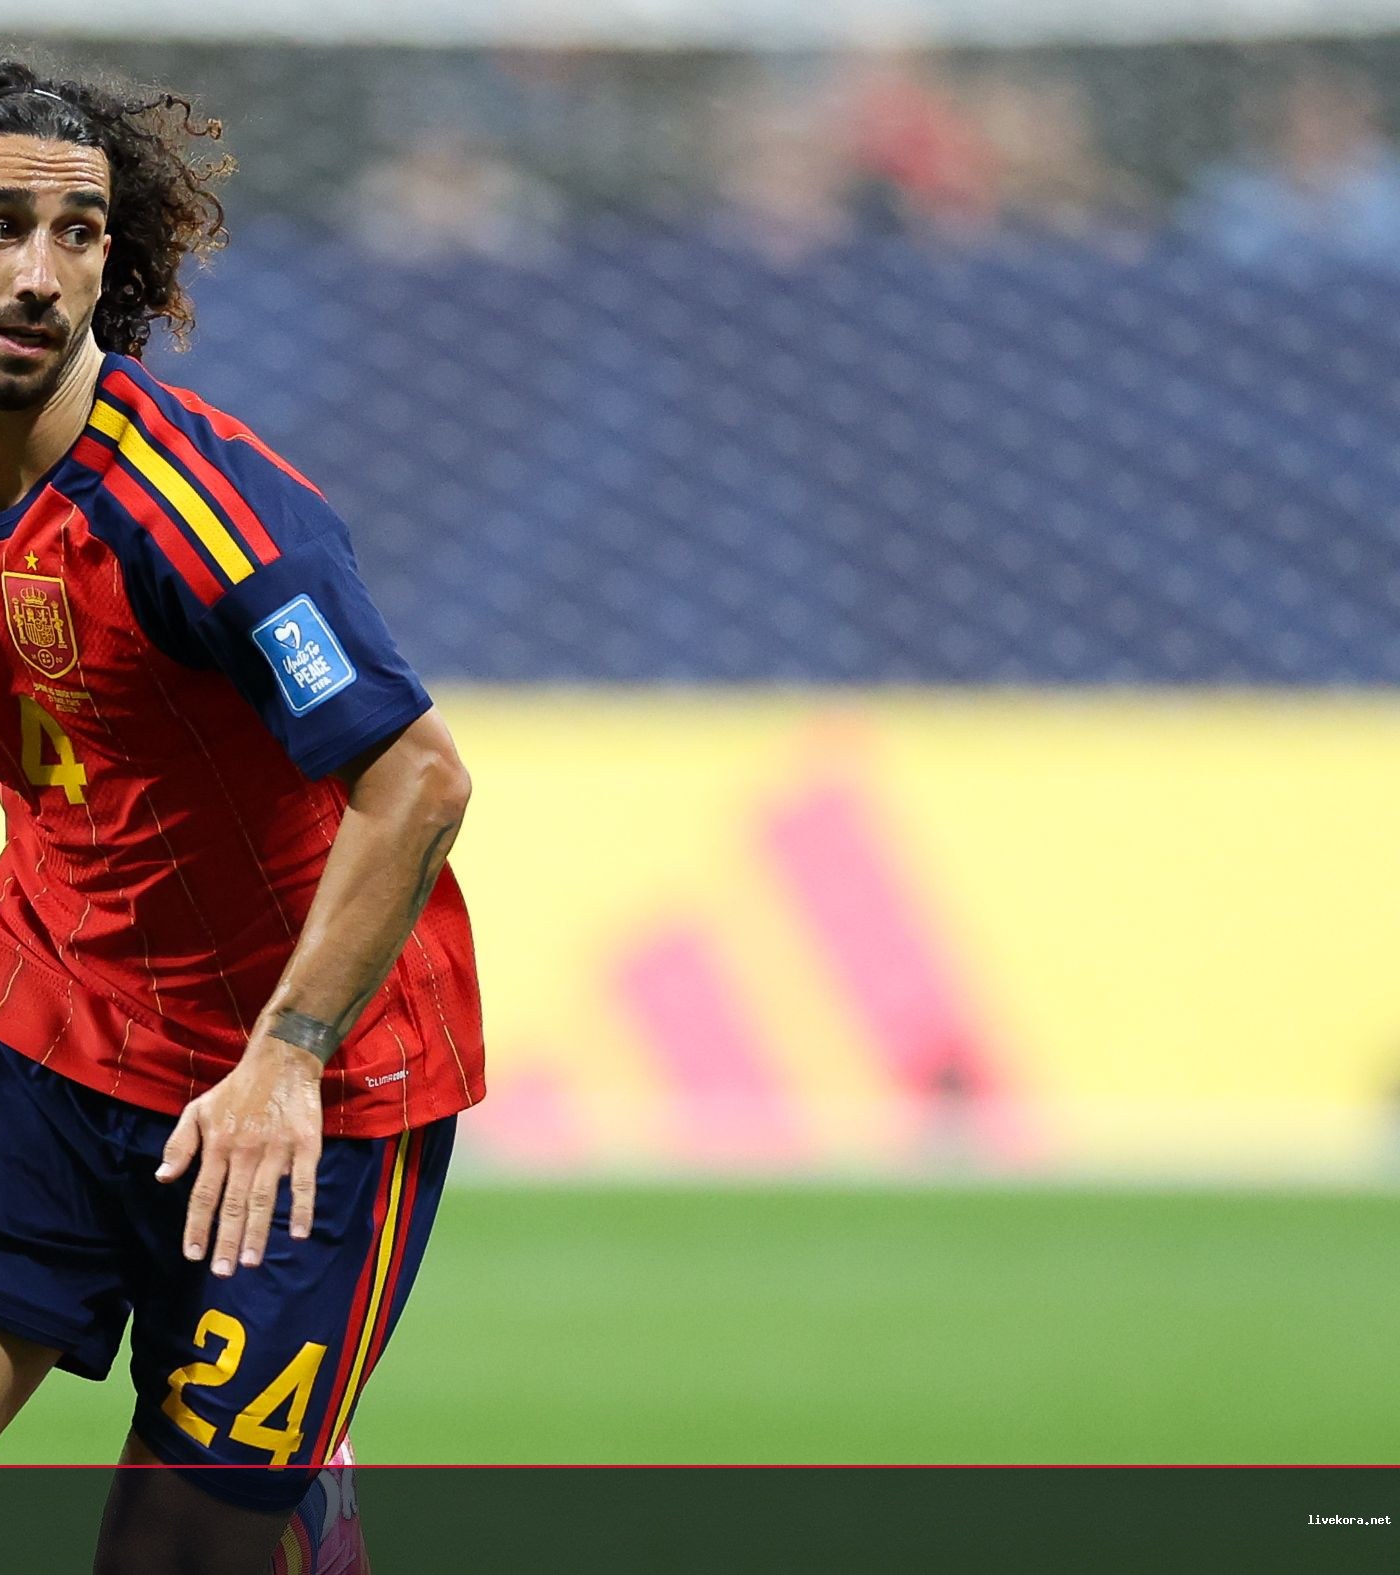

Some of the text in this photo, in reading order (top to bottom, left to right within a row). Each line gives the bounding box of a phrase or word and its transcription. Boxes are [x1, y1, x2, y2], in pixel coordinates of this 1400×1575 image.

[282, 650, 310, 675] Unite
[293, 655, 332, 689] PEACE
[310, 676, 332, 694] FIFA
[161, 1308, 329, 1472] 24
